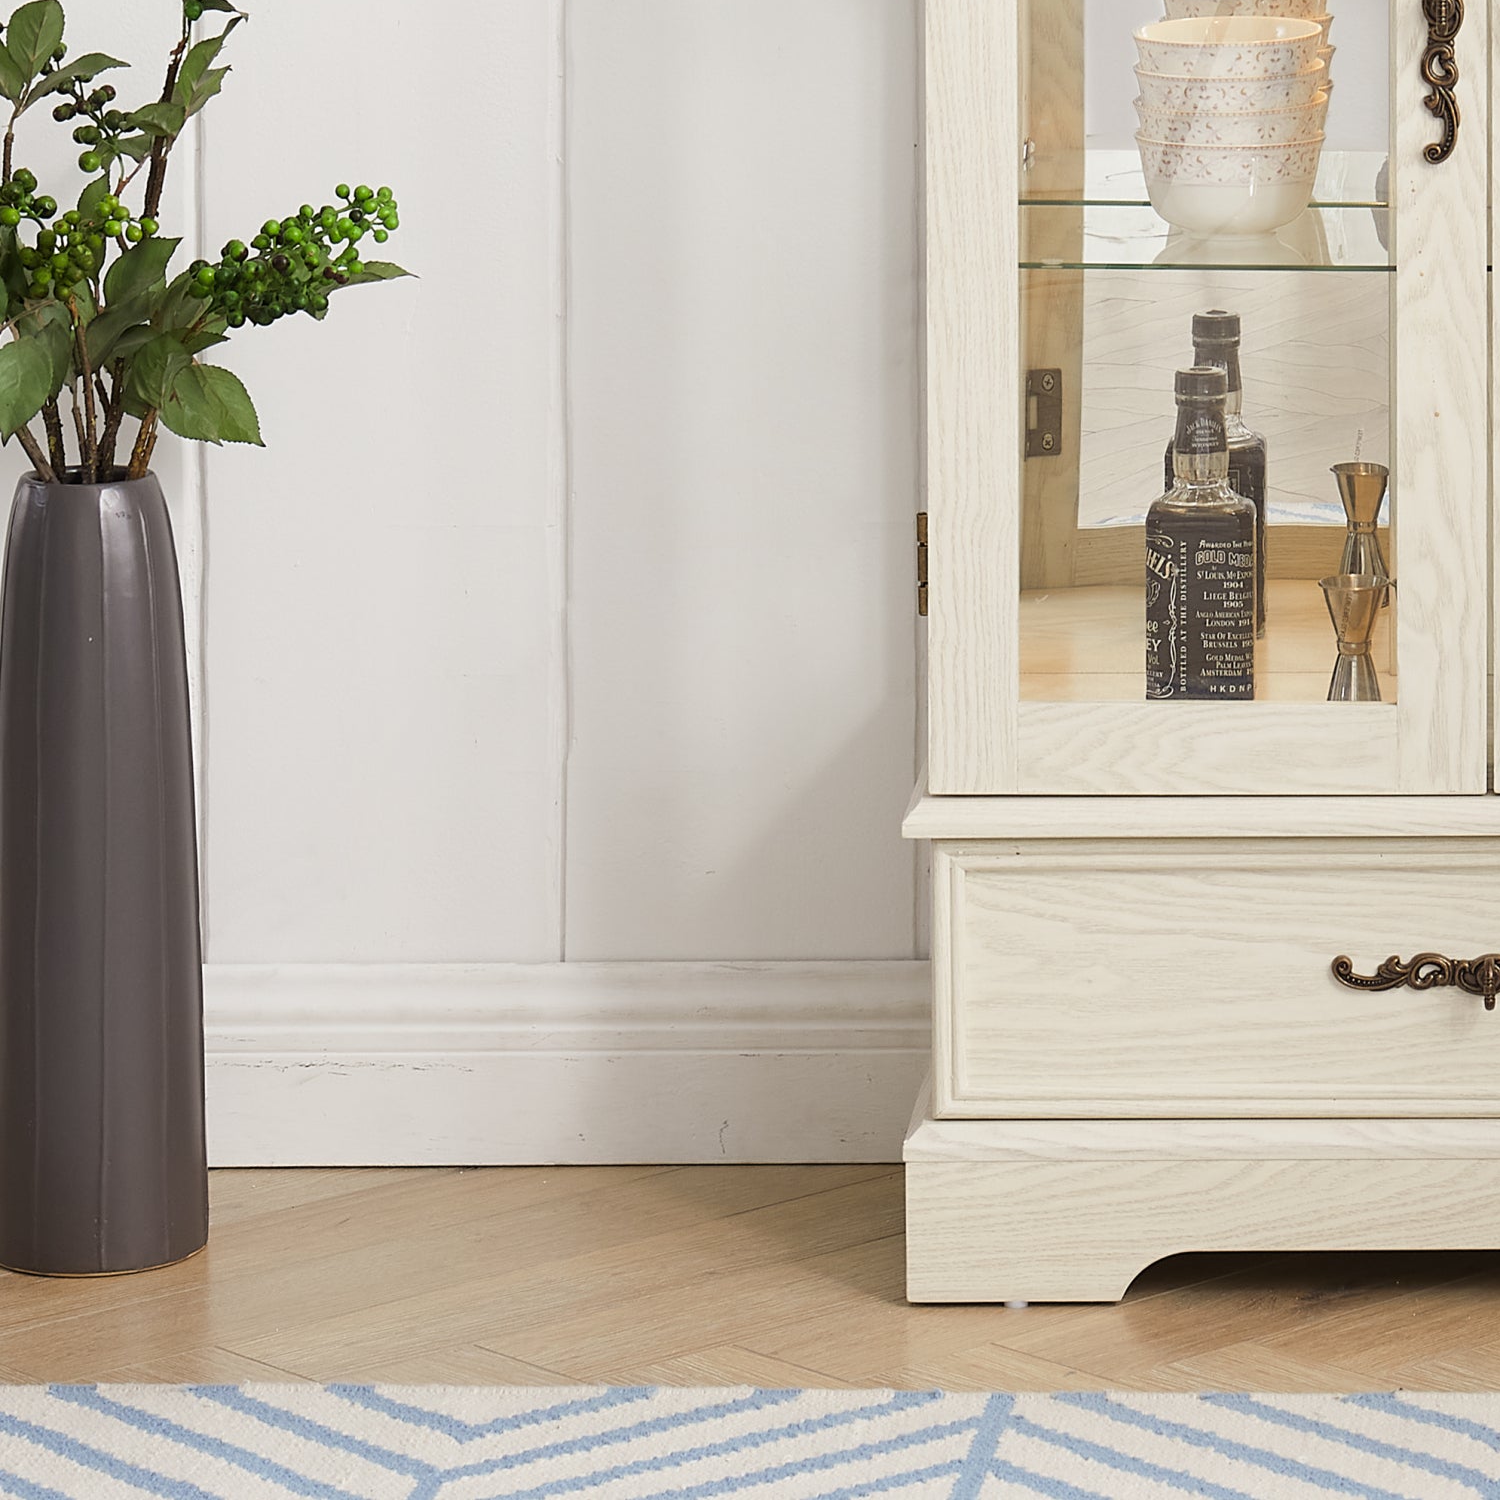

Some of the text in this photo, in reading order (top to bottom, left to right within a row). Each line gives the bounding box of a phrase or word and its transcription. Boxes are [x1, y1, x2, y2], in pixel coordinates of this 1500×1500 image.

[1195, 549, 1226, 566] GOLD
[1223, 581, 1244, 589] 1904
[1205, 618, 1235, 627] LONDON
[1180, 629, 1187, 642] AT
[1203, 640, 1238, 648] BRUSSELS
[1200, 667, 1243, 676] AMSTERDAM
